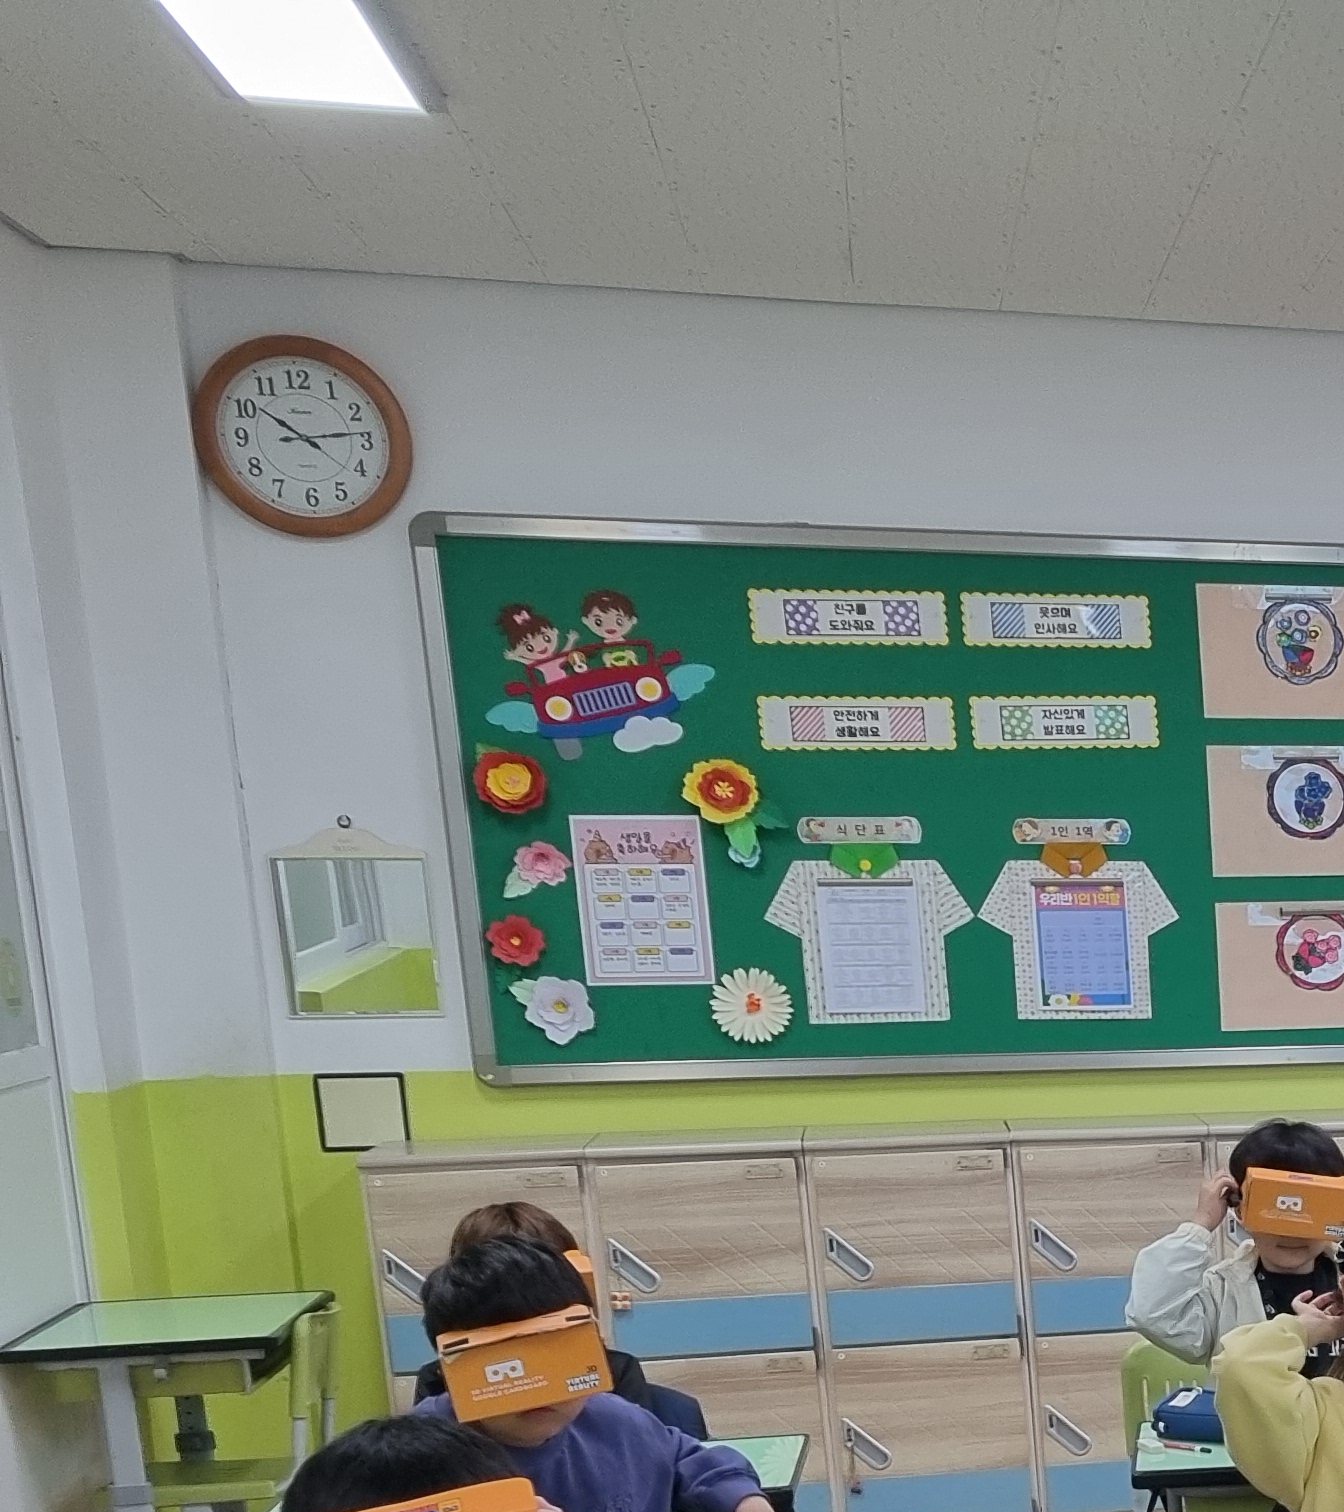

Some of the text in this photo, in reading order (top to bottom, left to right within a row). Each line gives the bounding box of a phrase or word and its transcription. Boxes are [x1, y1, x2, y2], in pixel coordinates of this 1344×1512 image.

[254, 375, 277, 397] 11
[283, 369, 311, 390] 12
[324, 380, 338, 400] 1
[235, 398, 257, 419] 10
[348, 402, 363, 422] 2
[234, 427, 249, 447] 9
[359, 432, 374, 451] 3
[247, 457, 263, 476] 8
[353, 458, 367, 477] 4
[272, 478, 285, 498] 7
[305, 487, 320, 507] 6
[334, 481, 348, 501] 5
[1034, 622, 1079, 635] 인사해요
[833, 709, 880, 723] 안전하게
[1041, 708, 1086, 721] 자신있게
[835, 724, 881, 739] 생활해요
[1043, 723, 1087, 737] 발표해요
[1050, 825, 1094, 838] 1인 1역
